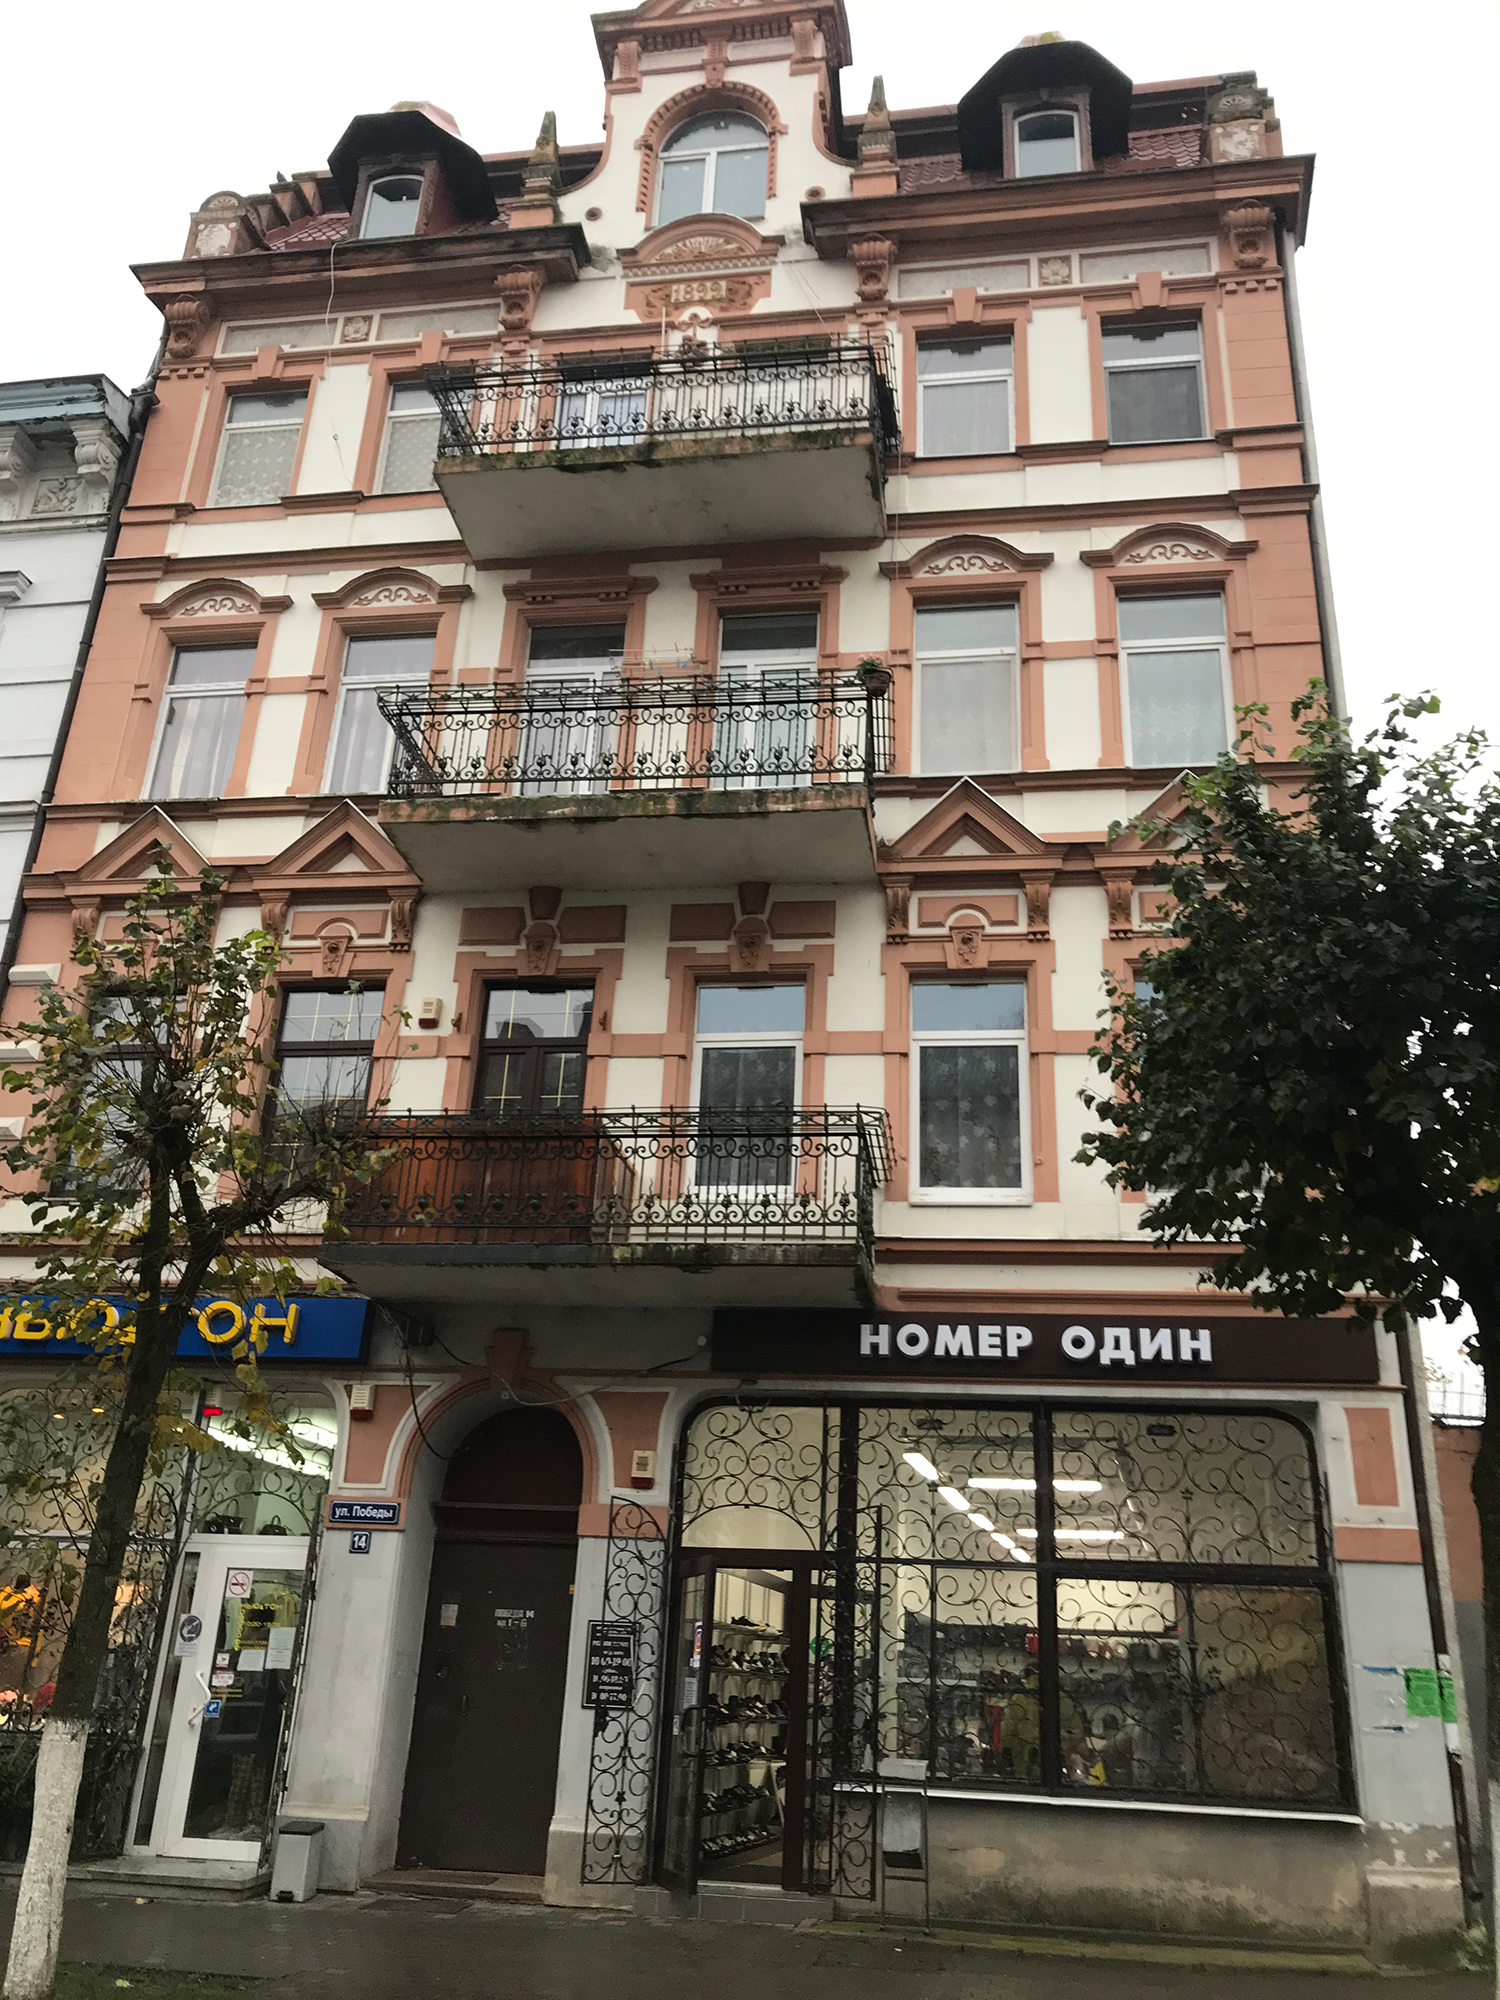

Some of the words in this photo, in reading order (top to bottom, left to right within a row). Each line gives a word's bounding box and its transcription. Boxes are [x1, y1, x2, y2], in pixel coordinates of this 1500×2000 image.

[673, 281, 724, 301] 1899
[860, 1323, 1034, 1358] НОМЕР
[1061, 1325, 1213, 1367] ОДИН
[335, 1507, 350, 1518] ул.
[352, 1505, 393, 1519] Победы
[353, 1535, 367, 1549] 14
